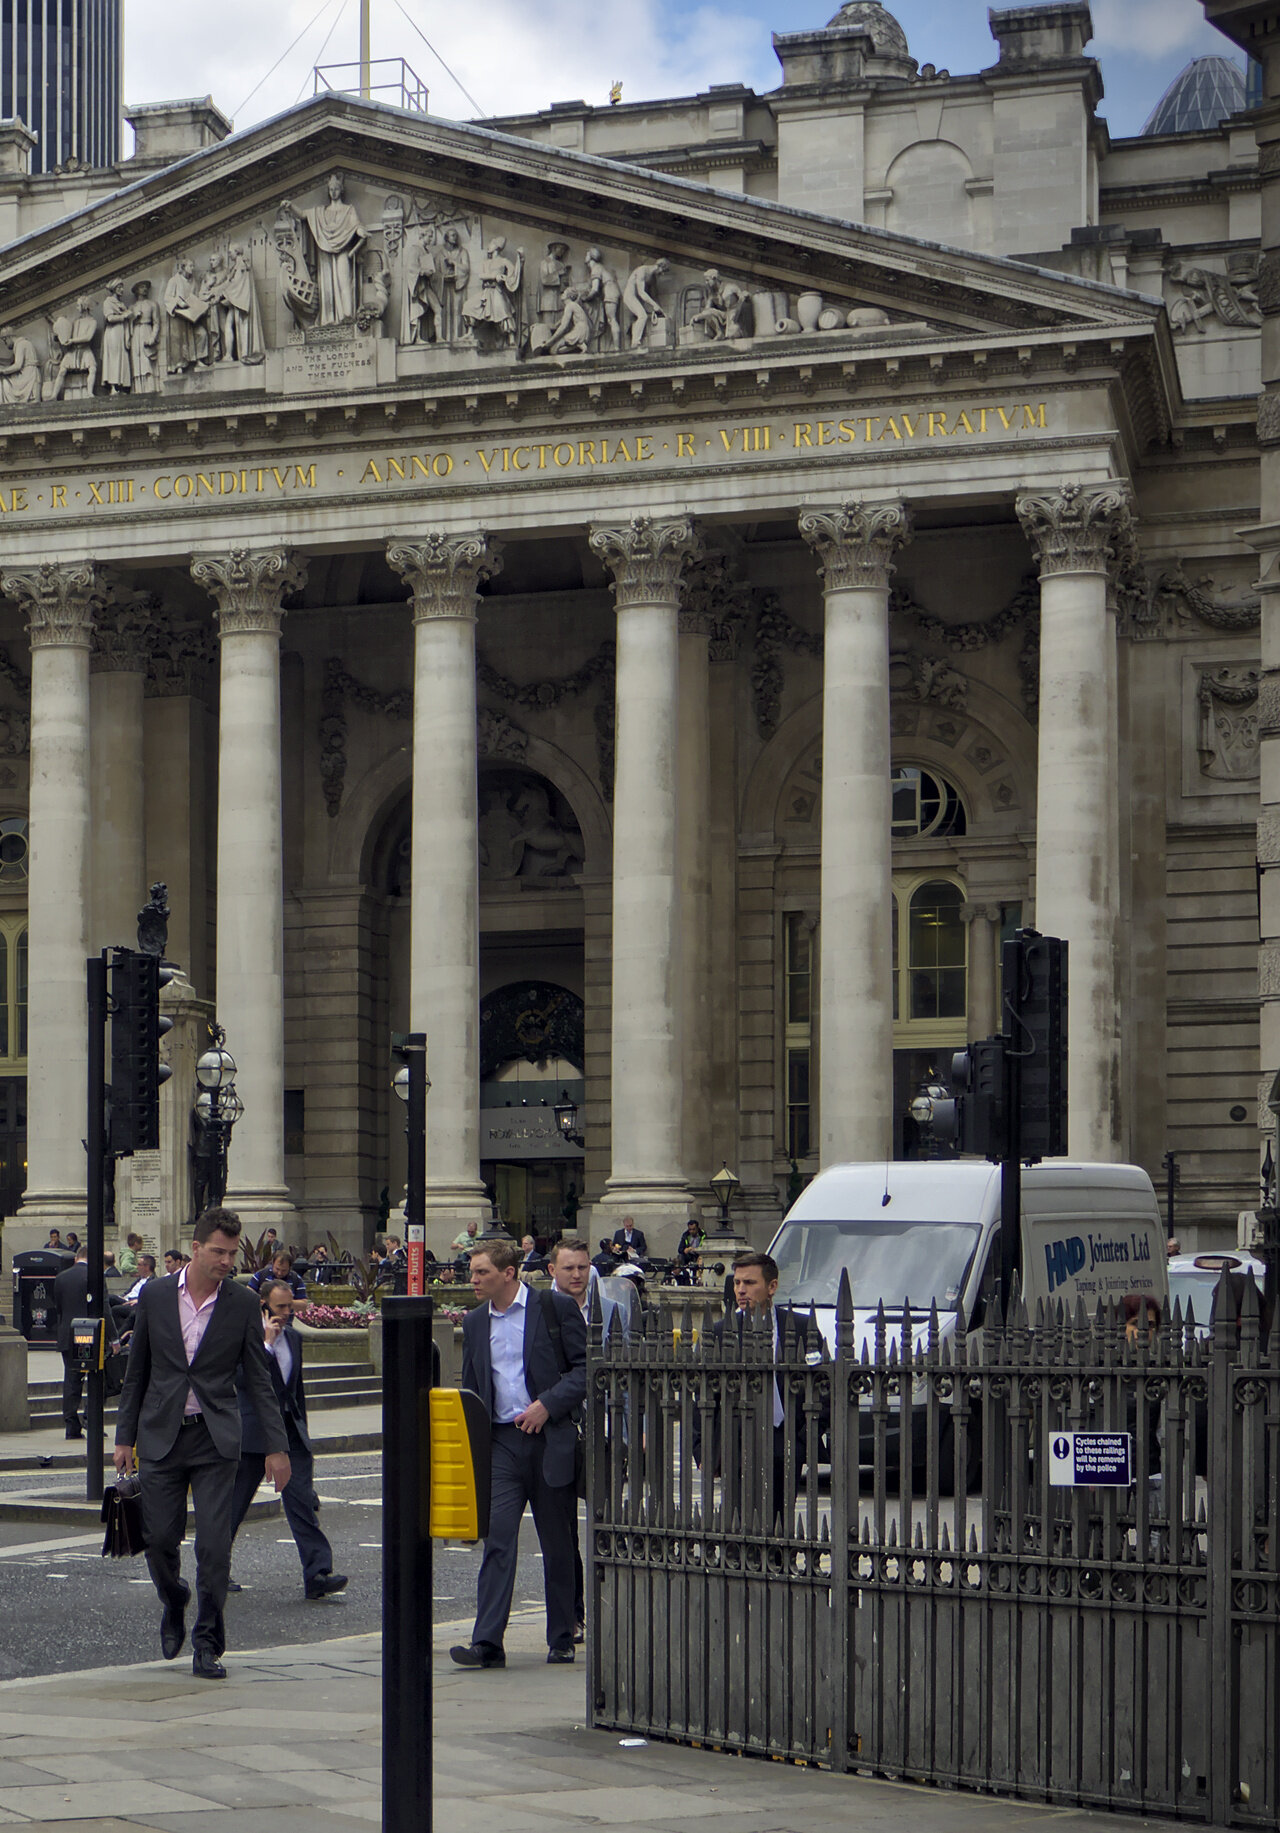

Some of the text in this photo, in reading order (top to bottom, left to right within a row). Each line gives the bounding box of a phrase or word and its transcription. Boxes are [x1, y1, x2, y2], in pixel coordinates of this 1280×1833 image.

[304, 355, 321, 363] THE
[285, 365, 303, 373] AND
[309, 363, 326, 371] THE
[50, 484, 68, 508] R
[87, 478, 135, 506] XIII
[153, 463, 318, 499] CONDITVM
[359, 452, 454, 484] ANNO
[476, 435, 655, 473] VICTORIAE
[675, 431, 697, 458] R
[718, 425, 772, 452] VIII
[792, 402, 1049, 448] RESTAVRATVM
[410, 1247, 419, 1275] butts
[1044, 1232, 1150, 1293] HND Jointers Ltd
[1075, 1278, 1097, 1295] Taping
[1104, 1276, 1128, 1294] Jointing
[1130, 1275, 1153, 1288] Services
[75, 1336, 93, 1344] WAIT
[1075, 1437, 1122, 1447] Cycles chained
[1102, 1447, 1126, 1456] railings
[1075, 1455, 1125, 1463] will be removed
[1076, 1464, 1117, 1473] by the police
